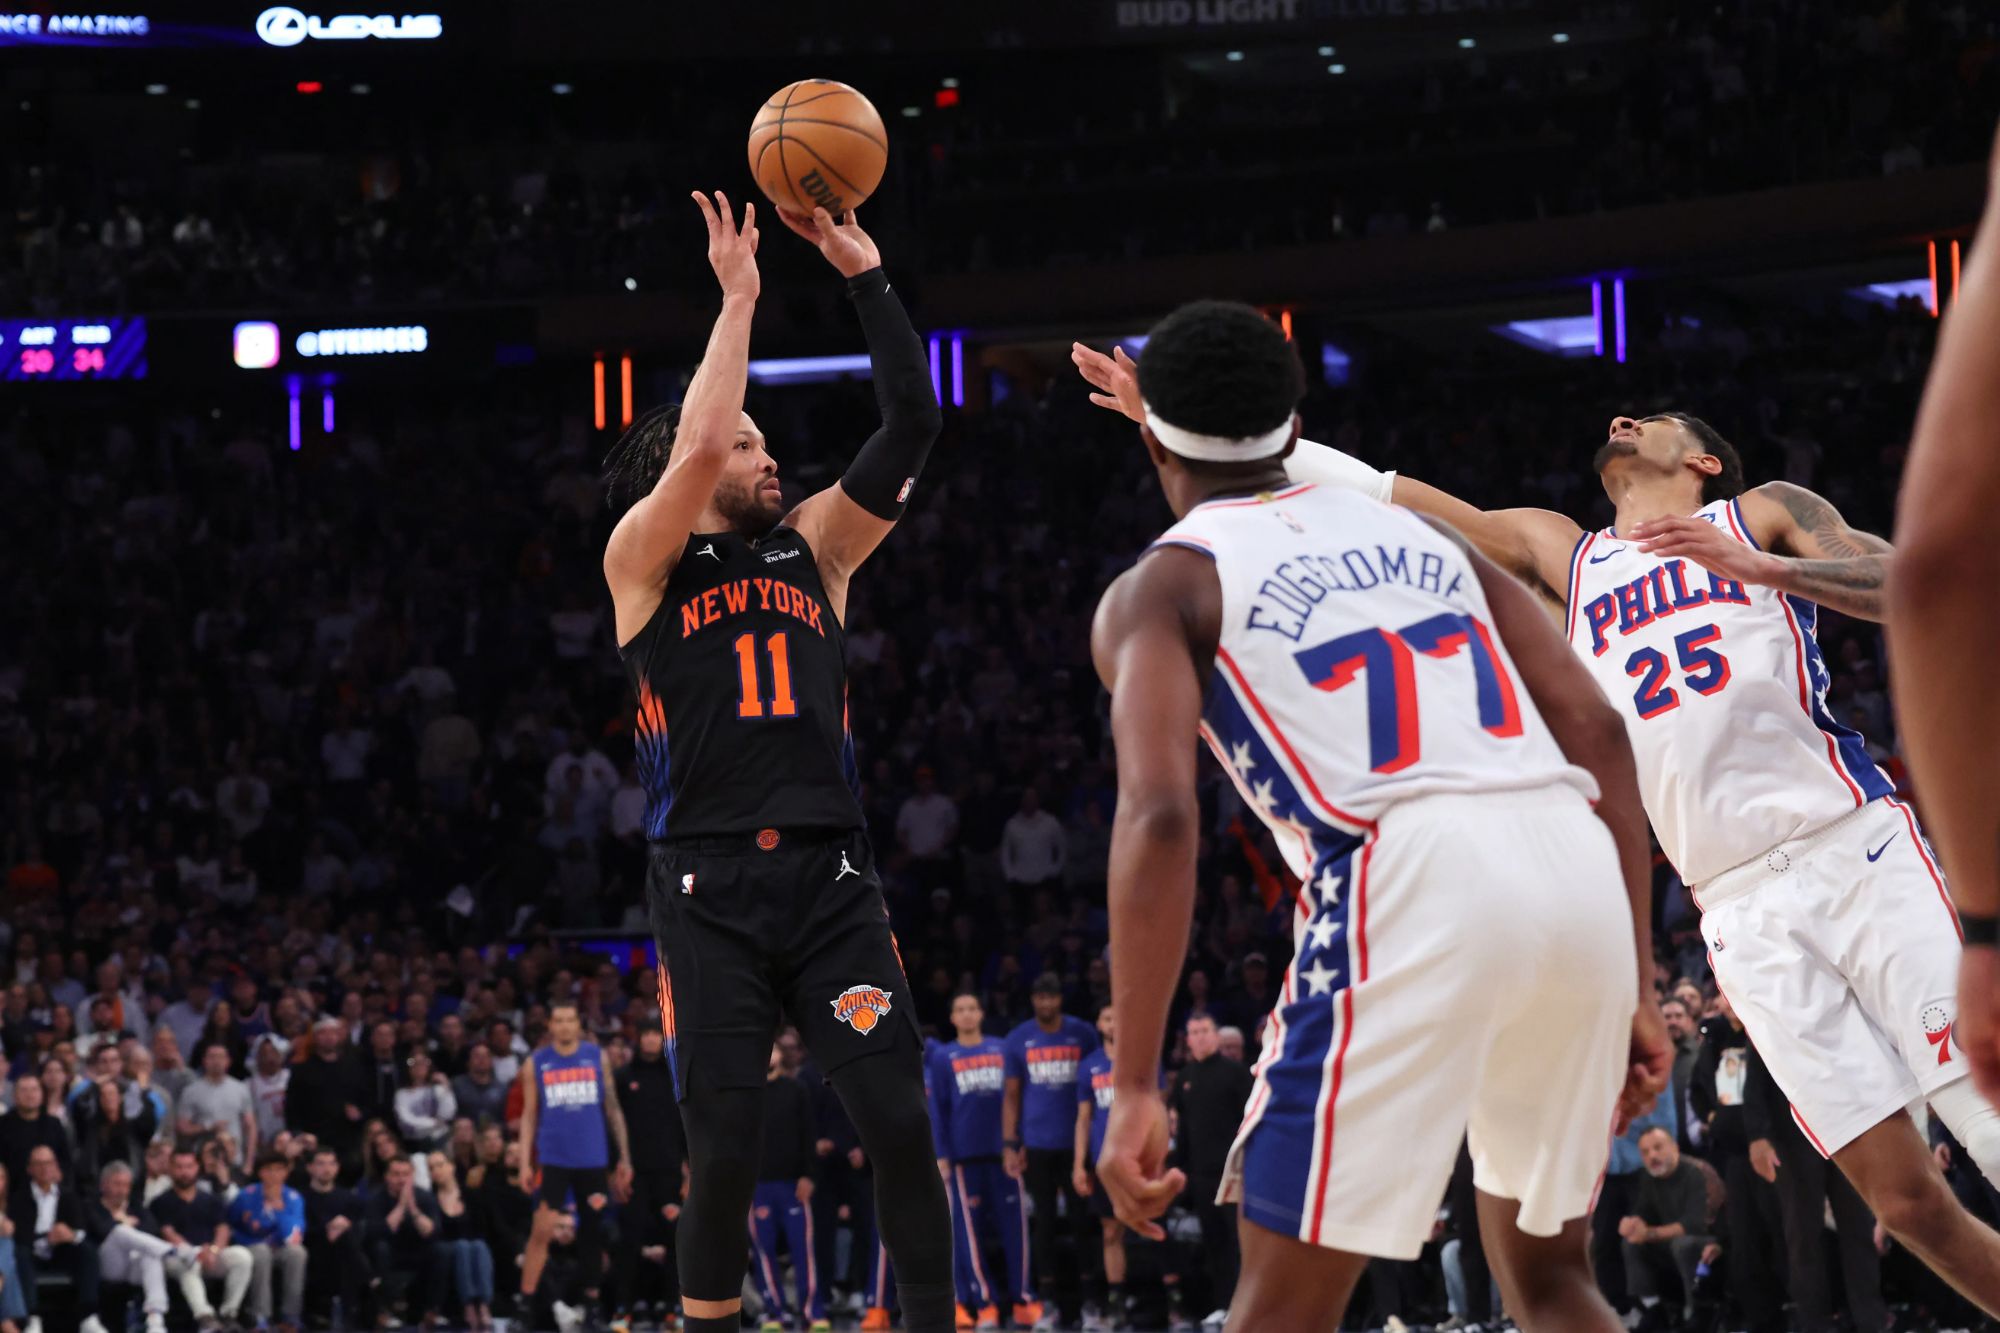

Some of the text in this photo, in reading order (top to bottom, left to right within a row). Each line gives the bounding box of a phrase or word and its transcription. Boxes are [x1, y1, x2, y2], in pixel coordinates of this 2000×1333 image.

[48, 15, 149, 36] AMAZING
[307, 15, 442, 39] LEXUS
[1117, 0, 1298, 26] BUD LIGHT
[681, 578, 826, 640] NEW YORK
[732, 628, 800, 720] 11
[1293, 612, 1523, 775] 77
[1624, 623, 1731, 720] 25
[836, 988, 891, 1018] KNICKS
